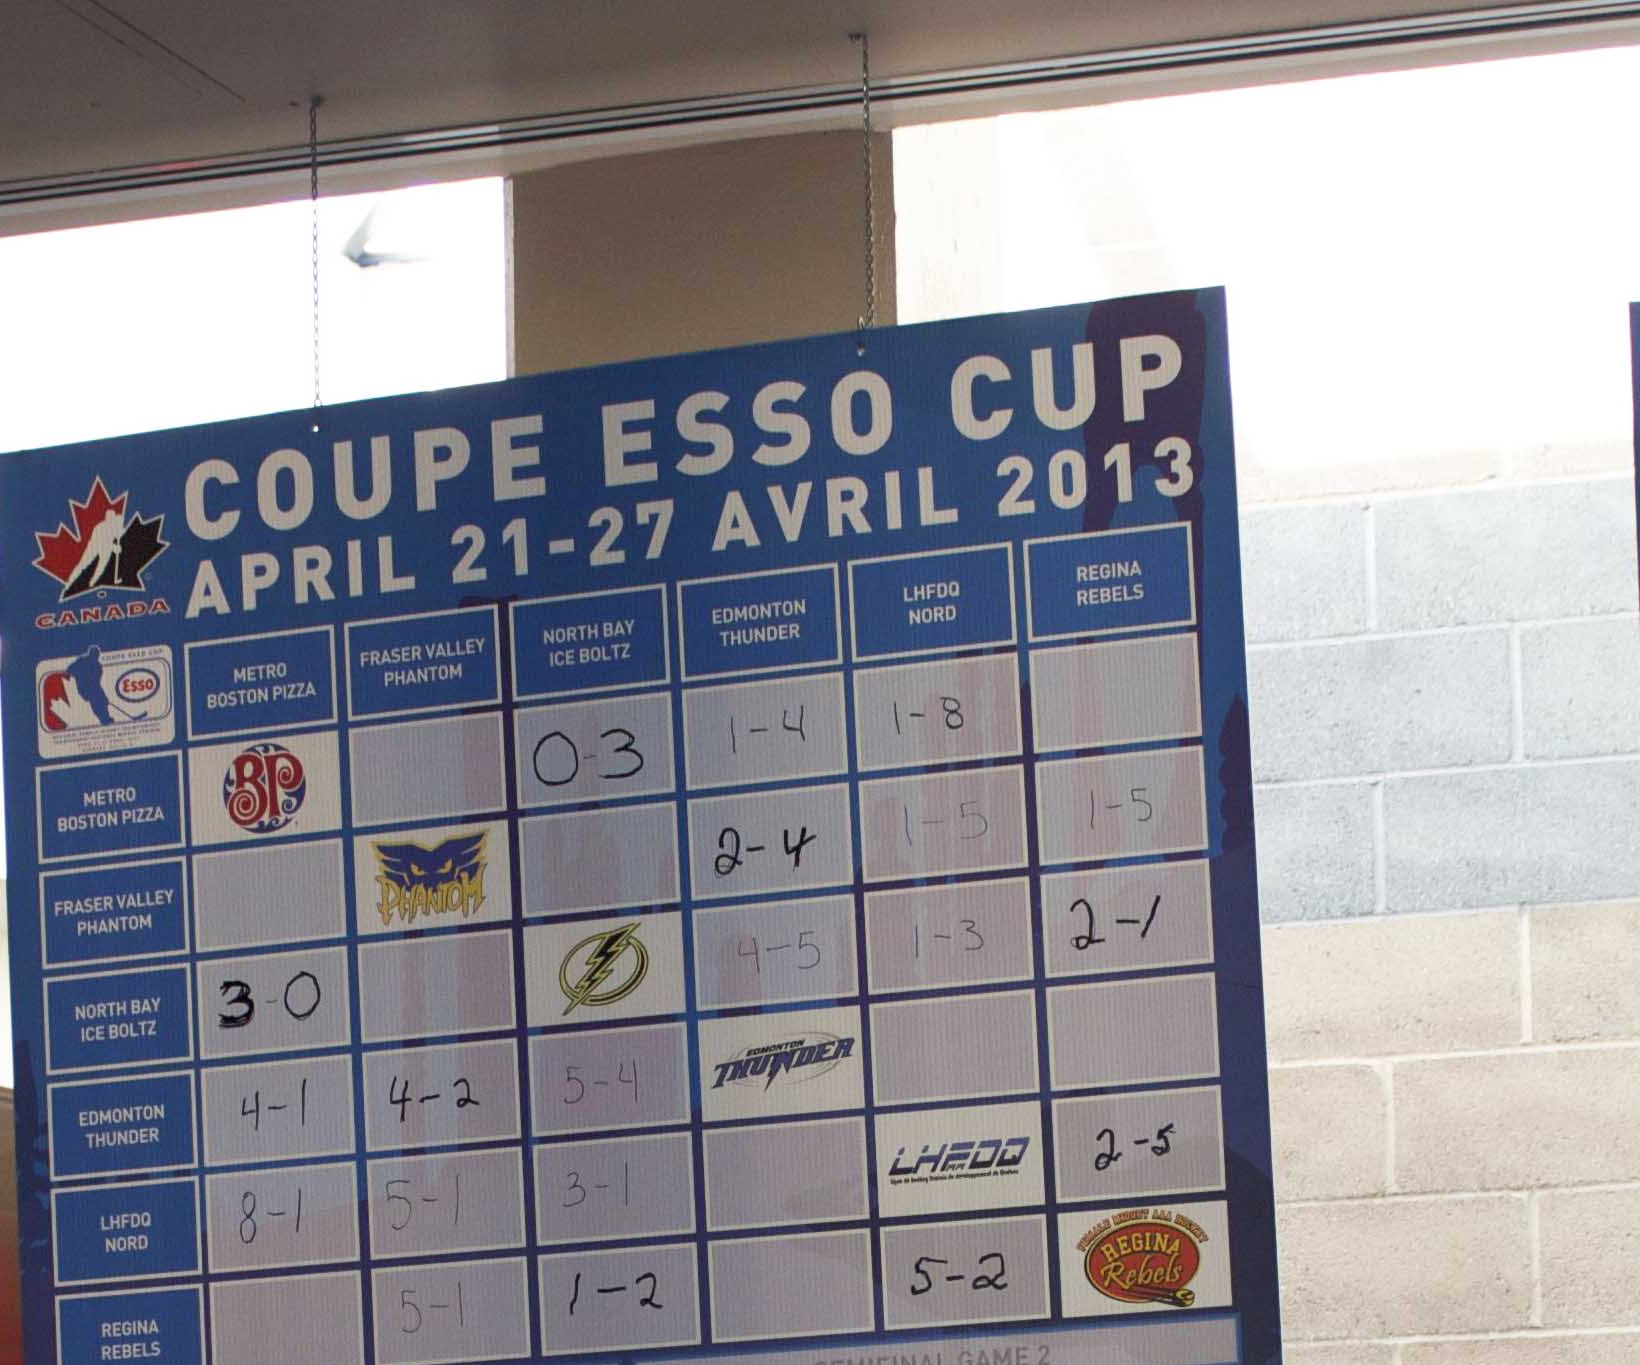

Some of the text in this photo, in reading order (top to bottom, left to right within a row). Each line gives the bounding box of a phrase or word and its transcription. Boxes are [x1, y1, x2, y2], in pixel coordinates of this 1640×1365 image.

[185, 335, 1181, 540] COUPE ESSO CUP
[186, 437, 1193, 618] APRIL 21-27 AVRIL 2013
[1077, 561, 1141, 582] REGINA
[904, 581, 959, 602] LHFDQ
[1077, 584, 1144, 606] REBELS
[35, 598, 171, 630] CANADA
[712, 599, 806, 624] EDMONTON
[909, 605, 956, 624] NORD
[543, 620, 634, 644] NORTH BAY
[720, 623, 800, 646] THUNDER
[360, 638, 485, 667] FRASER VALLEY
[550, 643, 630, 666] ICE BOLTZ
[234, 663, 287, 683] METRO
[384, 664, 462, 686] PHANTOM
[207, 682, 316, 709] BOSTON PIZZA
[1101, 1234, 1182, 1261] REGINA
[1104, 1256, 1185, 1287] Rebels
